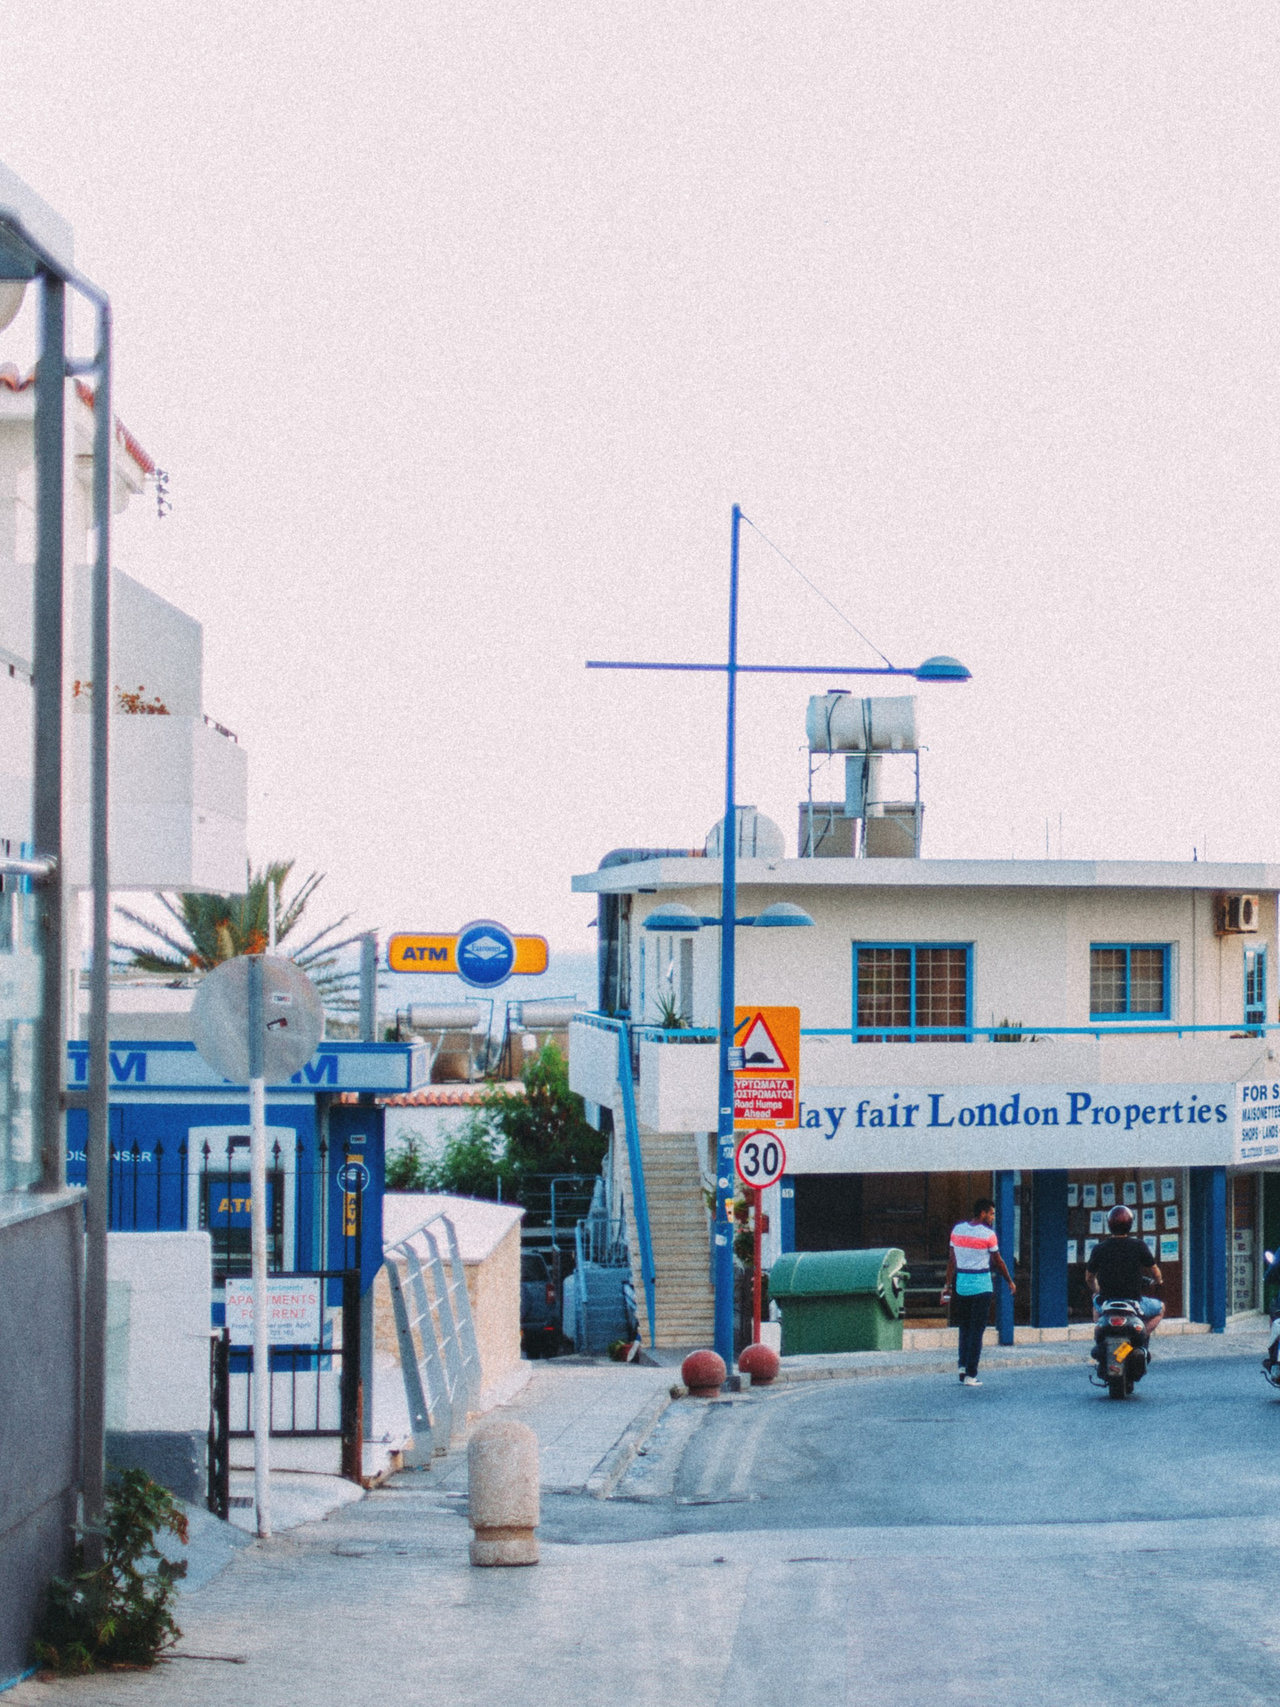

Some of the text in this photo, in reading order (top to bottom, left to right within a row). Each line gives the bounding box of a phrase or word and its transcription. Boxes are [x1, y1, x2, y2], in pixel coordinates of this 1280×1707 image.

[402, 946, 448, 961] ATM
[734, 1080, 789, 1090] ΥΡΤΩΜΑΤΑ
[1242, 1084, 1268, 1102] FOR
[734, 1099, 783, 1111] Road Humps
[926, 1092, 1060, 1127] London
[1066, 1091, 1228, 1130] Properties
[743, 1108, 771, 1118] Ahead
[743, 1142, 779, 1178] 30
[228, 1294, 317, 1306] APATMENTS
[272, 1307, 307, 1319] RENT
